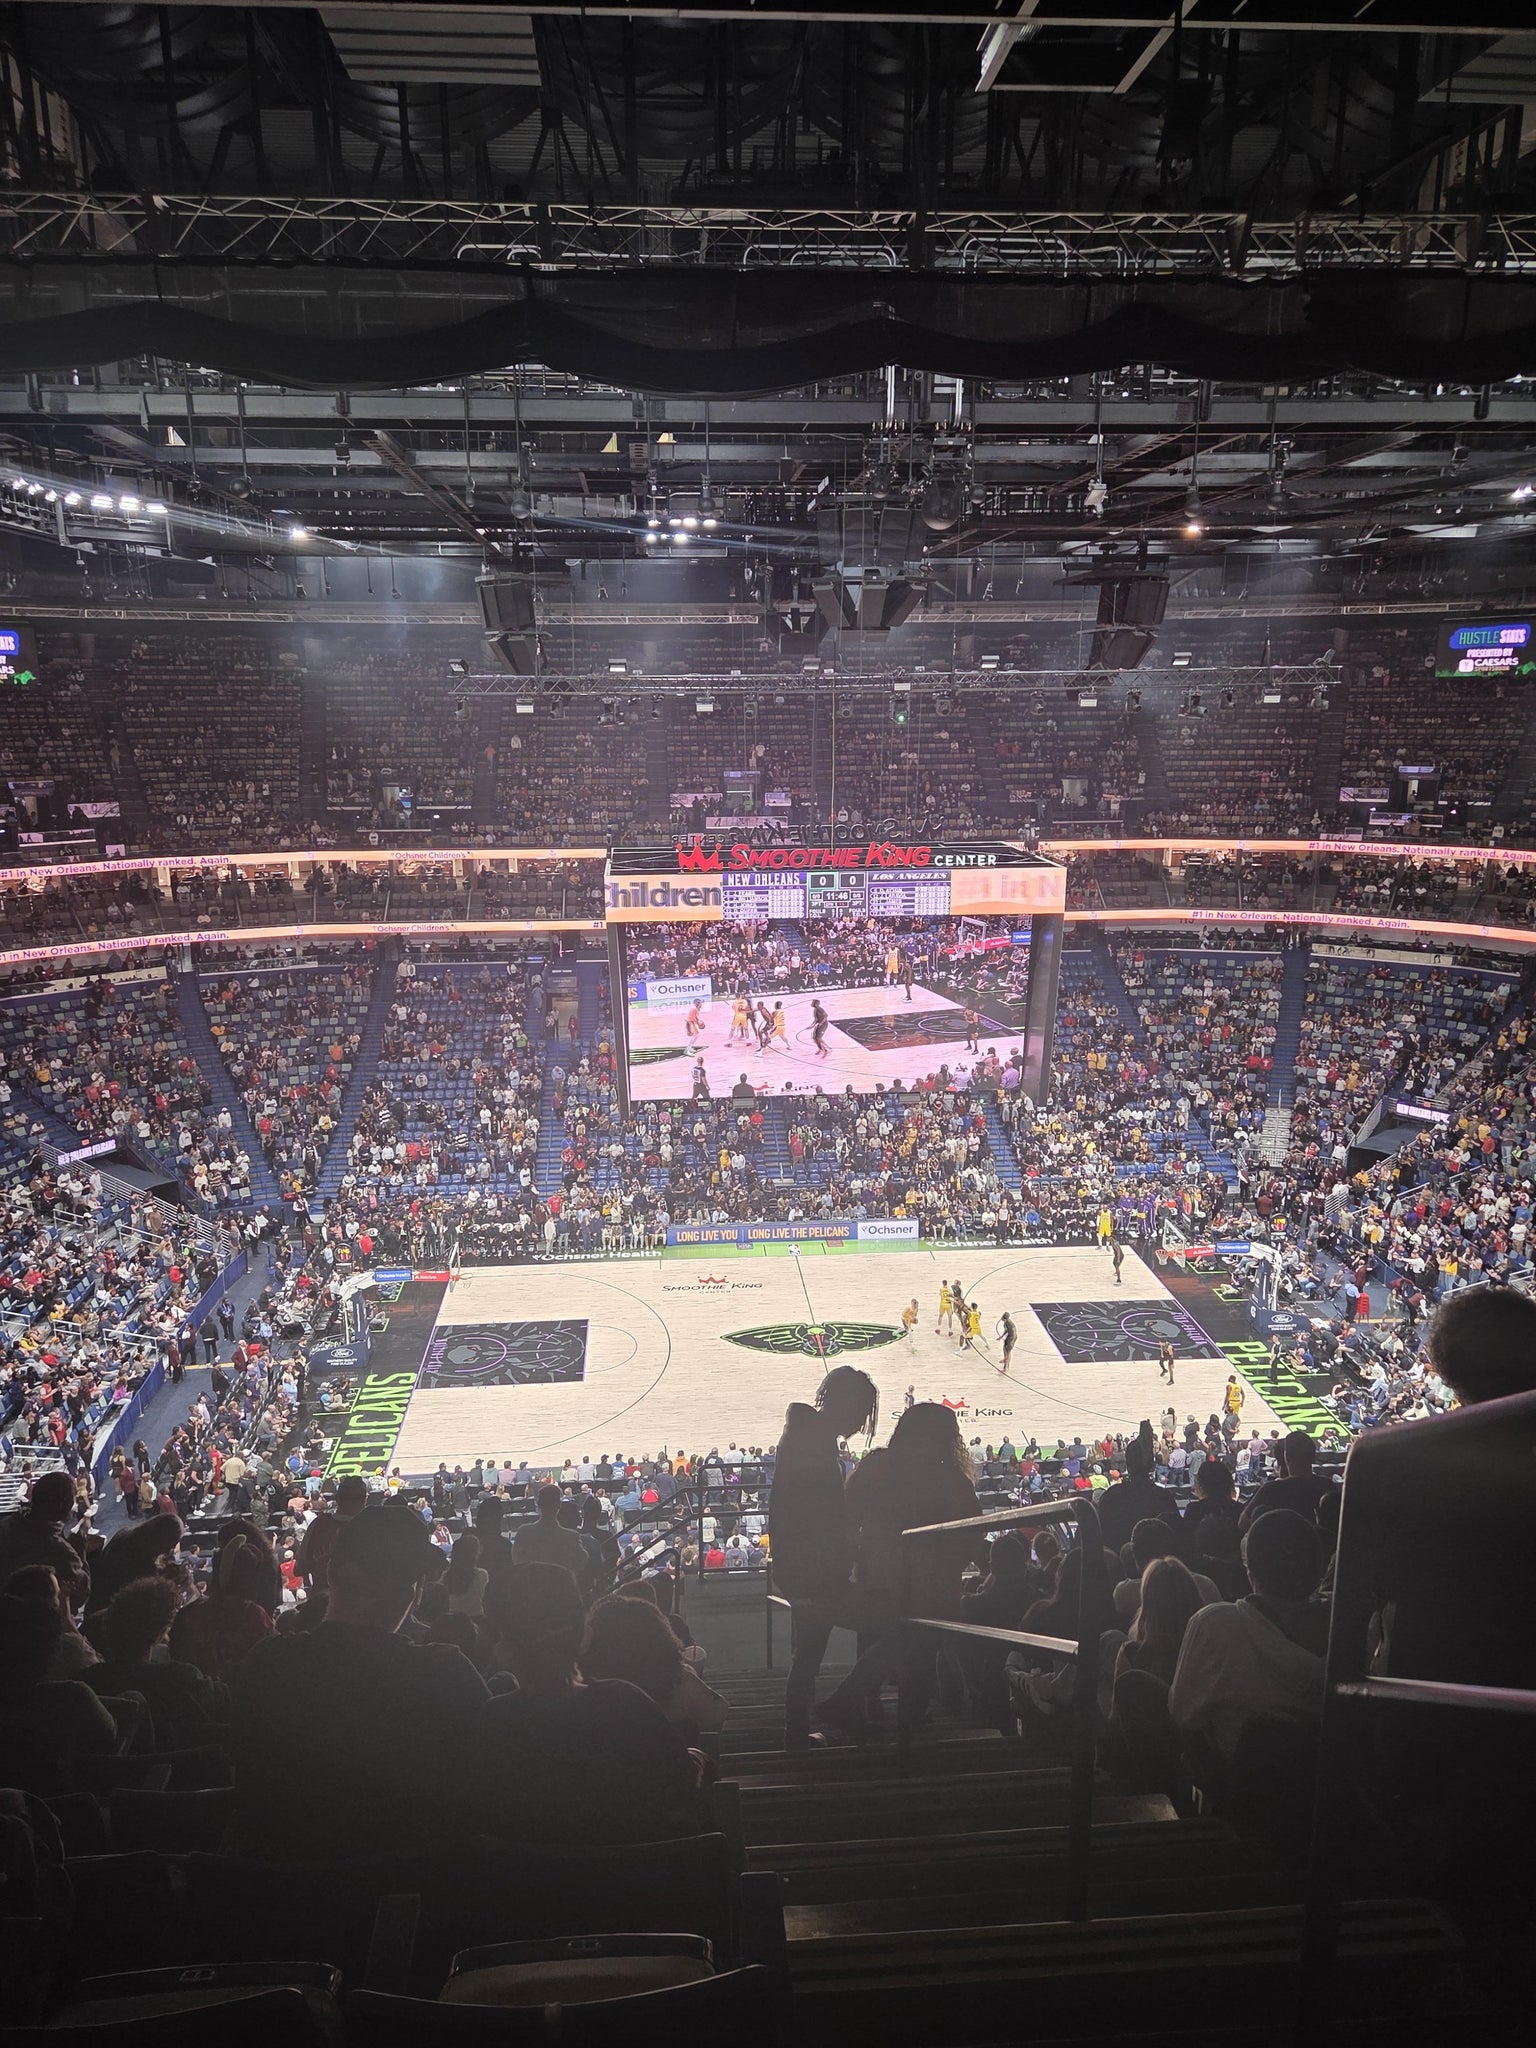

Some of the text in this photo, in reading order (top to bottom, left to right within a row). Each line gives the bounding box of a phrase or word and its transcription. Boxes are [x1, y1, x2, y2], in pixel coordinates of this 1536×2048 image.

[1459, 631, 1500, 645] HUSTLE
[1466, 648, 1513, 658] PRESENTED BY
[1475, 657, 1519, 666] CAESARS
[728, 844, 864, 869] SMOOTHIE
[934, 854, 997, 867] CENTER
[1334, 843, 1356, 851] New
[1359, 844, 1400, 853] Orleans.
[1402, 846, 1456, 857] Nationally
[1460, 848, 1499, 858] ranked.
[1502, 851, 1535, 862] Again.
[1, 856, 232, 878] #1 in New Orleans. Nationally ranked. Again.
[728, 872, 800, 886] NEW ORLEANS
[819, 875, 856, 886] 0 0
[896, 873, 947, 881] ANGELES
[1217, 911, 1237, 919] New
[1240, 912, 1280, 920] Orleans.
[1283, 913, 1333, 924] Nationally
[1336, 916, 1374, 926] ranked.
[1377, 919, 1410, 929] Again.
[377, 924, 450, 933] Ochsner Children's
[10, 952, 19, 960] in
[23, 950, 47, 959] New
[51, 946, 95, 955] Orleans.
[98, 936, 151, 949] Nationally
[154, 933, 193, 944] ranked.
[197, 932, 229, 942] Again.
[657, 983, 706, 995] Ochsner
[676, 1226, 850, 1242] LONG LIVE YOU LONG LIVE THE PELICANS
[868, 1225, 914, 1236] Ochsner
[542, 1250, 661, 1261] Ochsner Health
[1216, 1341, 1348, 1437] PELICANS
[331, 1372, 417, 1477] PELICANS
